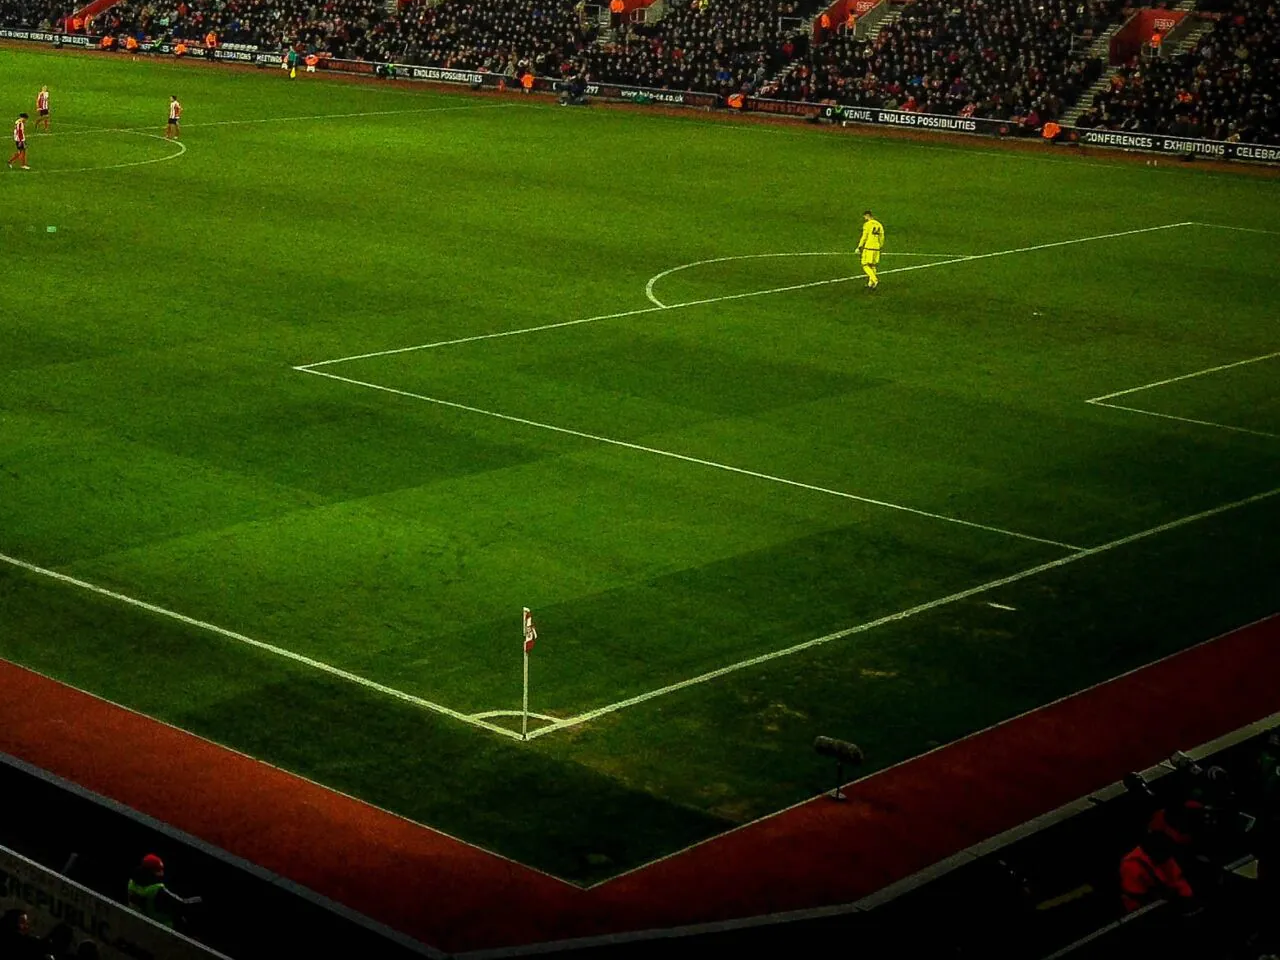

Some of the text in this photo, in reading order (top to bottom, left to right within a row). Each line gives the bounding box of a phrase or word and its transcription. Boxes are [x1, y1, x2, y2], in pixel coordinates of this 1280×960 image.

[414, 68, 440, 79] ENDLESS
[441, 70, 483, 83] POSSIBILITIES
[878, 112, 916, 125] ENDLESS
[917, 116, 977, 131] POSSIBILITIES
[1085, 131, 1153, 148] CONFERENCES
[1163, 139, 1225, 155] EXHIBITIONS
